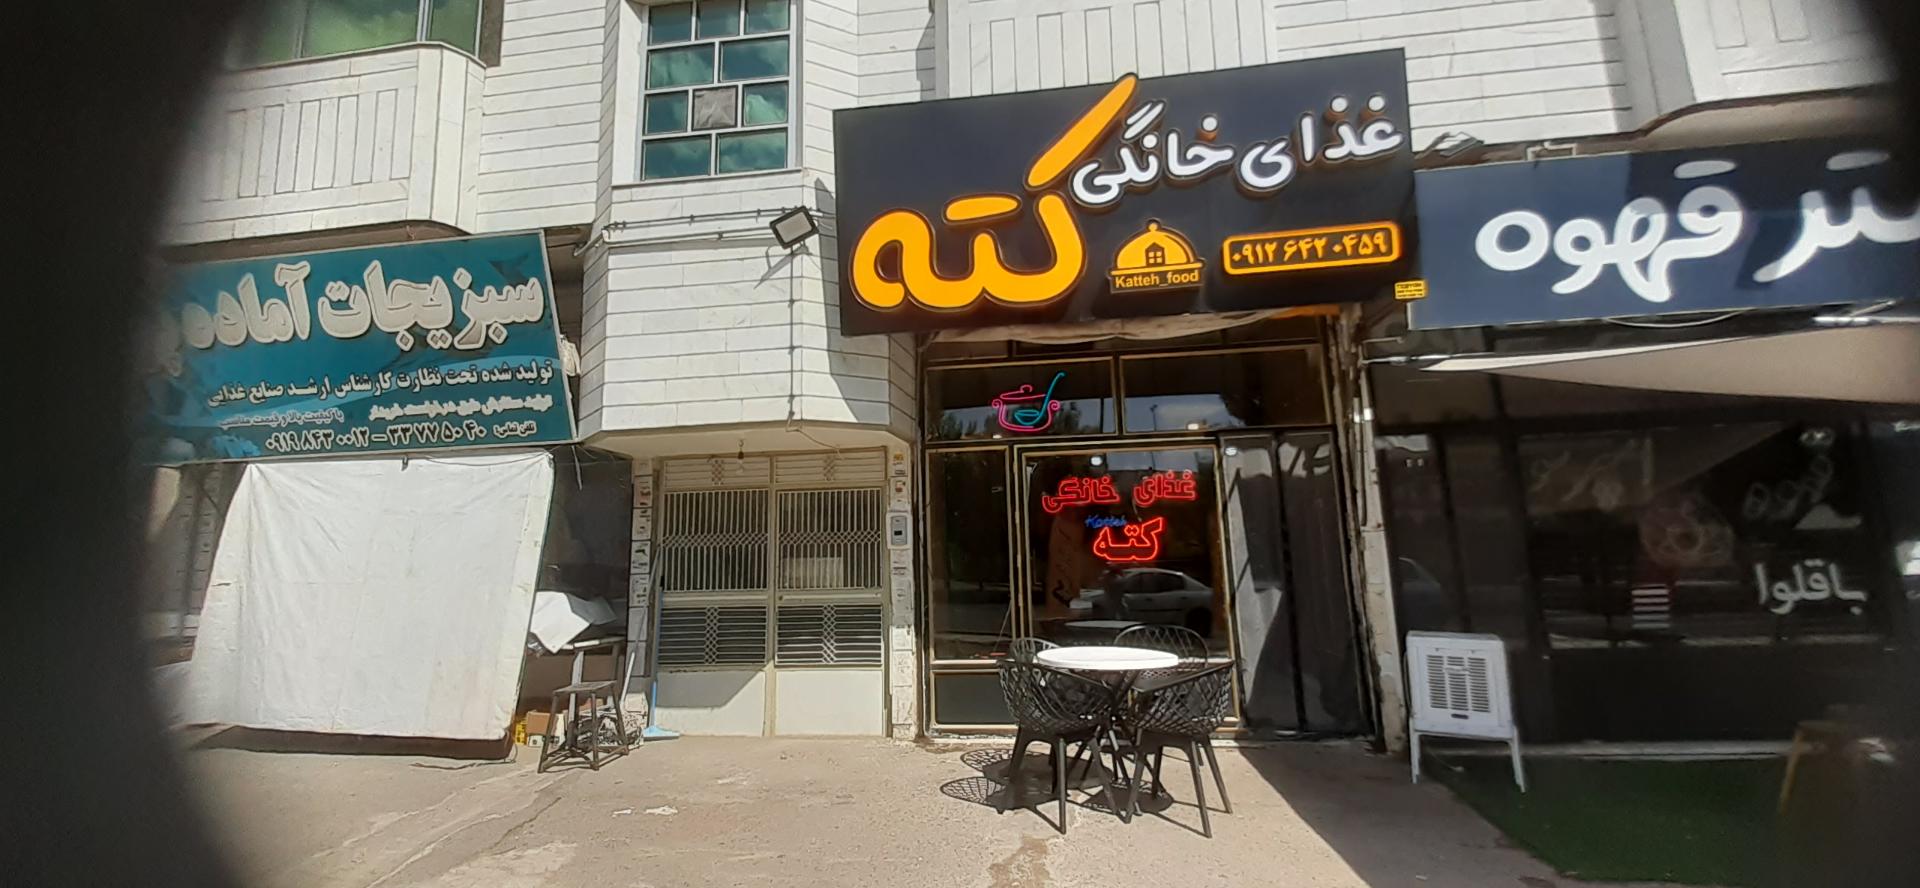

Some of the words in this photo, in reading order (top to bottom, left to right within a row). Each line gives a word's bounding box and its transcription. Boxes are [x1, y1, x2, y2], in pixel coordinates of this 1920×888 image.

[1072, 101, 1235, 205] خانگی
[1239, 95, 1401, 189] غذای
[853, 74, 1138, 308] کته
[1475, 159, 1744, 303] قهوه
[1231, 244, 1276, 265] ۰۹۱۲
[1114, 271, 1200, 289] Katteh_food
[181, 260, 311, 349] آماده
[316, 259, 545, 352] سبزیجات
[334, 371, 393, 398] کارشناس
[396, 366, 443, 393] نظارت
[445, 364, 479, 386] تحت
[481, 362, 512, 384] شده
[515, 361, 554, 385] تولید
[207, 384, 247, 408] غذایی
[249, 380, 285, 405] صنایع
[287, 375, 331, 400] ارشد
[1133, 470, 1196, 507] غذای
[1093, 516, 1163, 561] کته
[1755, 558, 1868, 616] باقلوا
